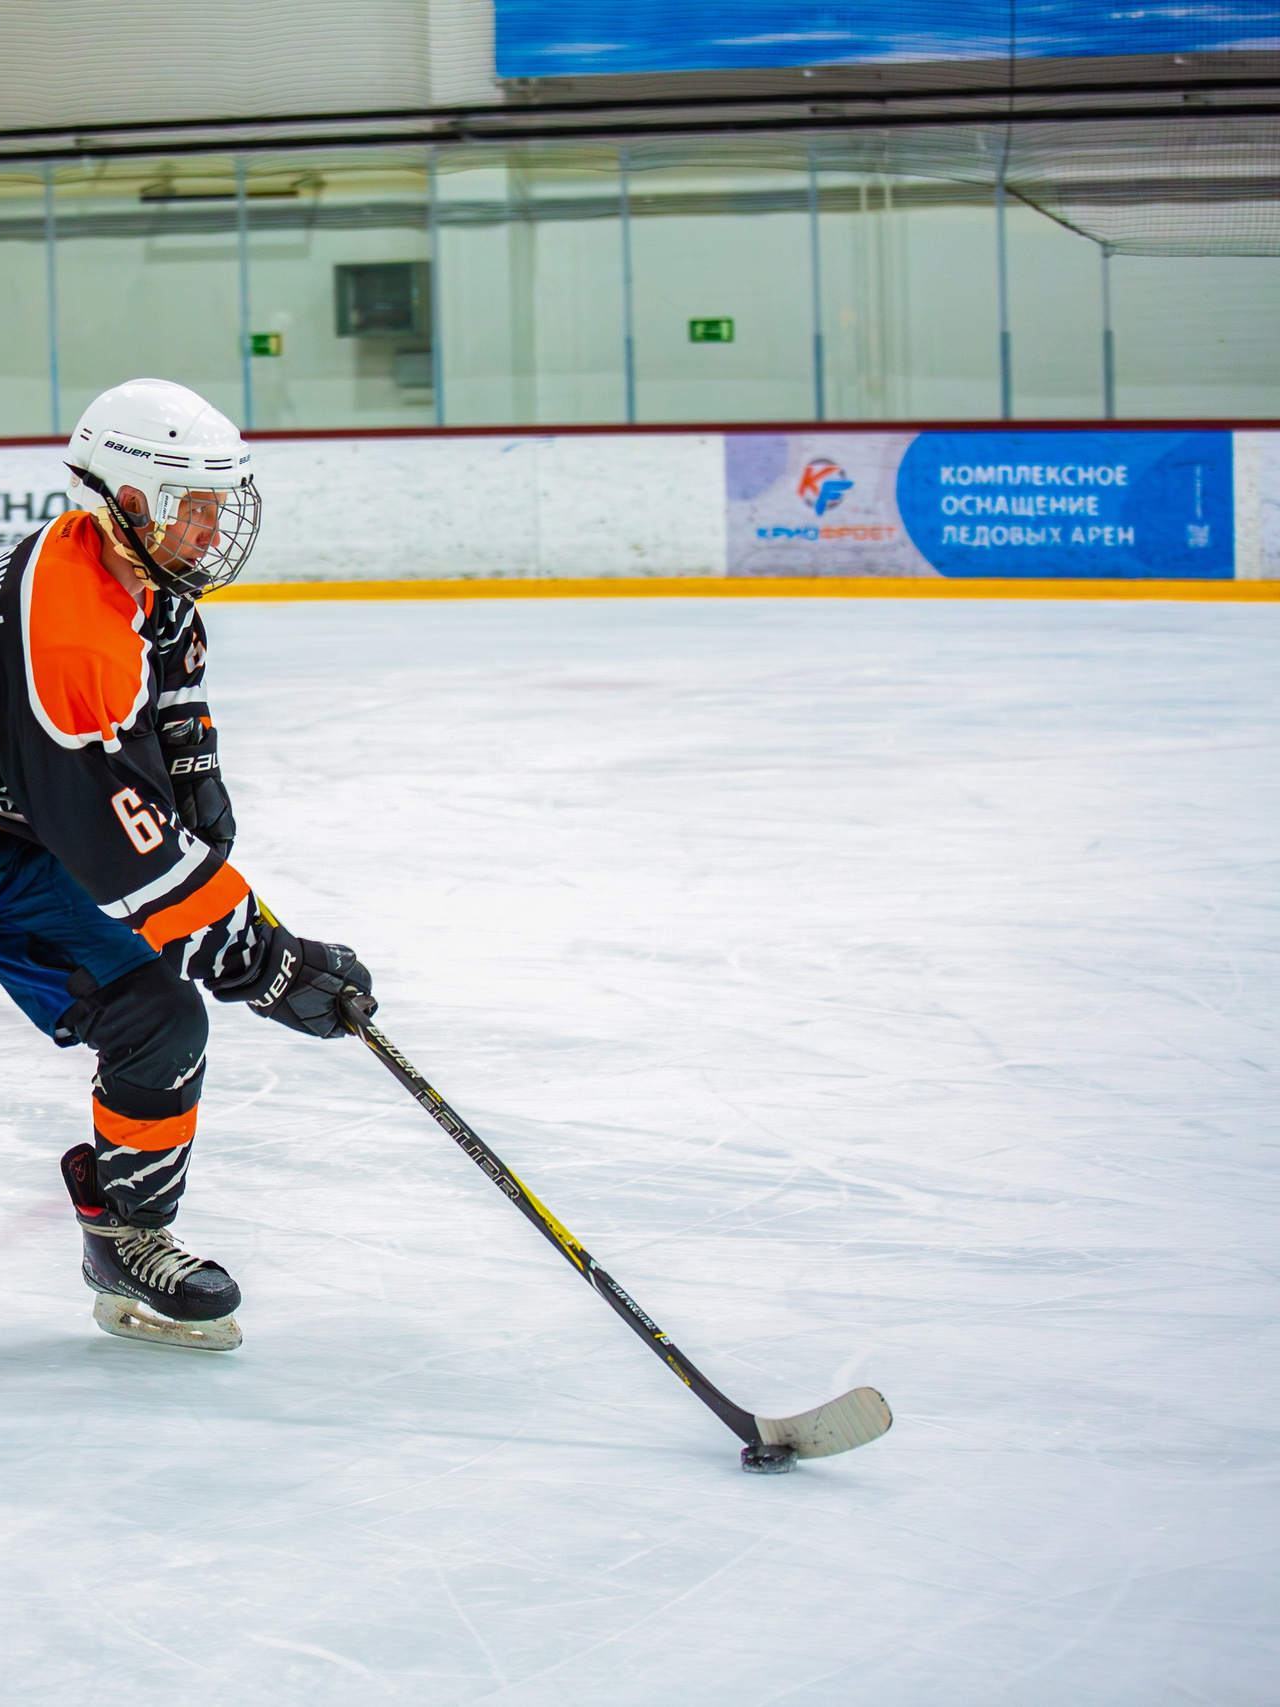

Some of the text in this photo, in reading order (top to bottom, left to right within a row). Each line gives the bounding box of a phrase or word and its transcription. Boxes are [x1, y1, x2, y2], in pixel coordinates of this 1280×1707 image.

[104, 440, 152, 460] BAUER
[940, 465, 1128, 486] КОМПЛЕКСНОЕ
[940, 495, 1100, 517] ОСНАЩЕНИЕ
[940, 525, 1135, 547] ЛЕДОВЫХ АРЕН
[170, 753, 219, 775] BAU
[250, 949, 297, 1008] UER
[366, 1025, 420, 1079] BAUER
[415, 1089, 520, 1199] BAUER
